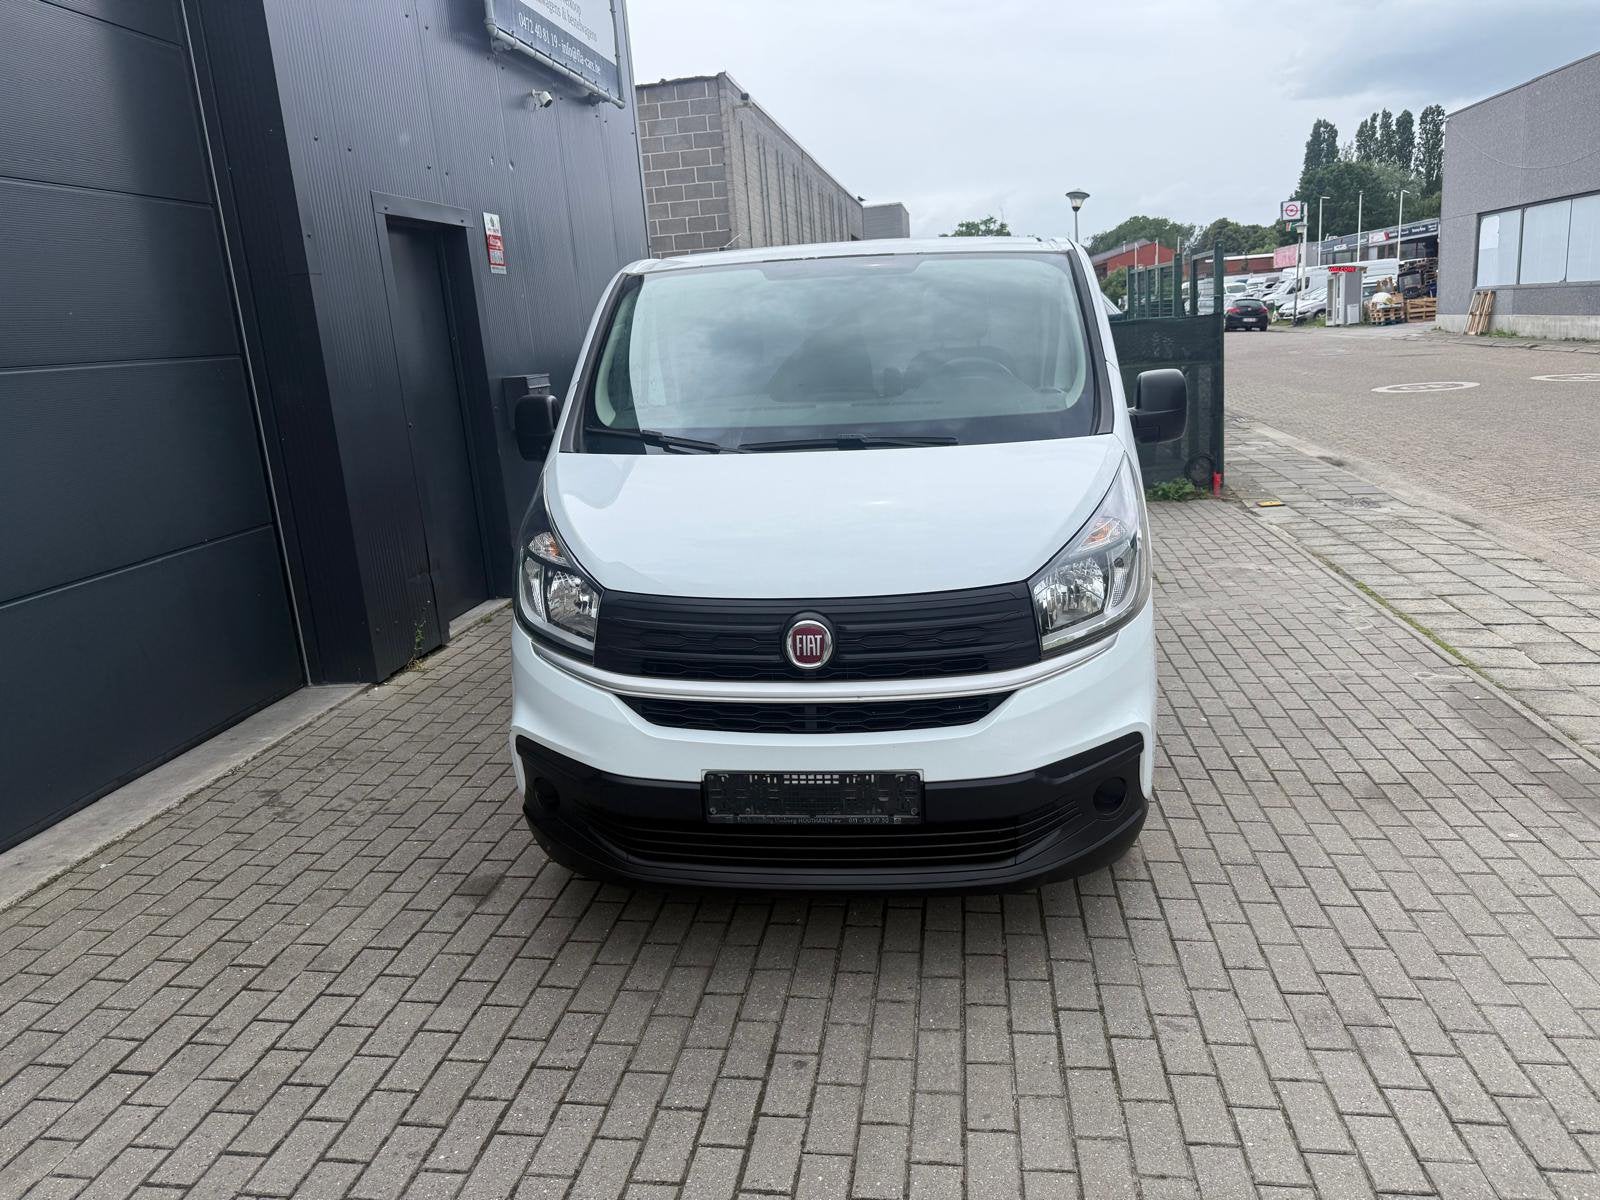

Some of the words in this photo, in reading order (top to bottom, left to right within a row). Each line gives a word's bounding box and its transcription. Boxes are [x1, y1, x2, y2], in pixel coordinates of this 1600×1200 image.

[518, 12, 534, 34] 0472
[534, 22, 543, 39] 40
[542, 27, 550, 45] 81
[551, 32, 559, 48] 19
[796, 635, 823, 656] FIAT
